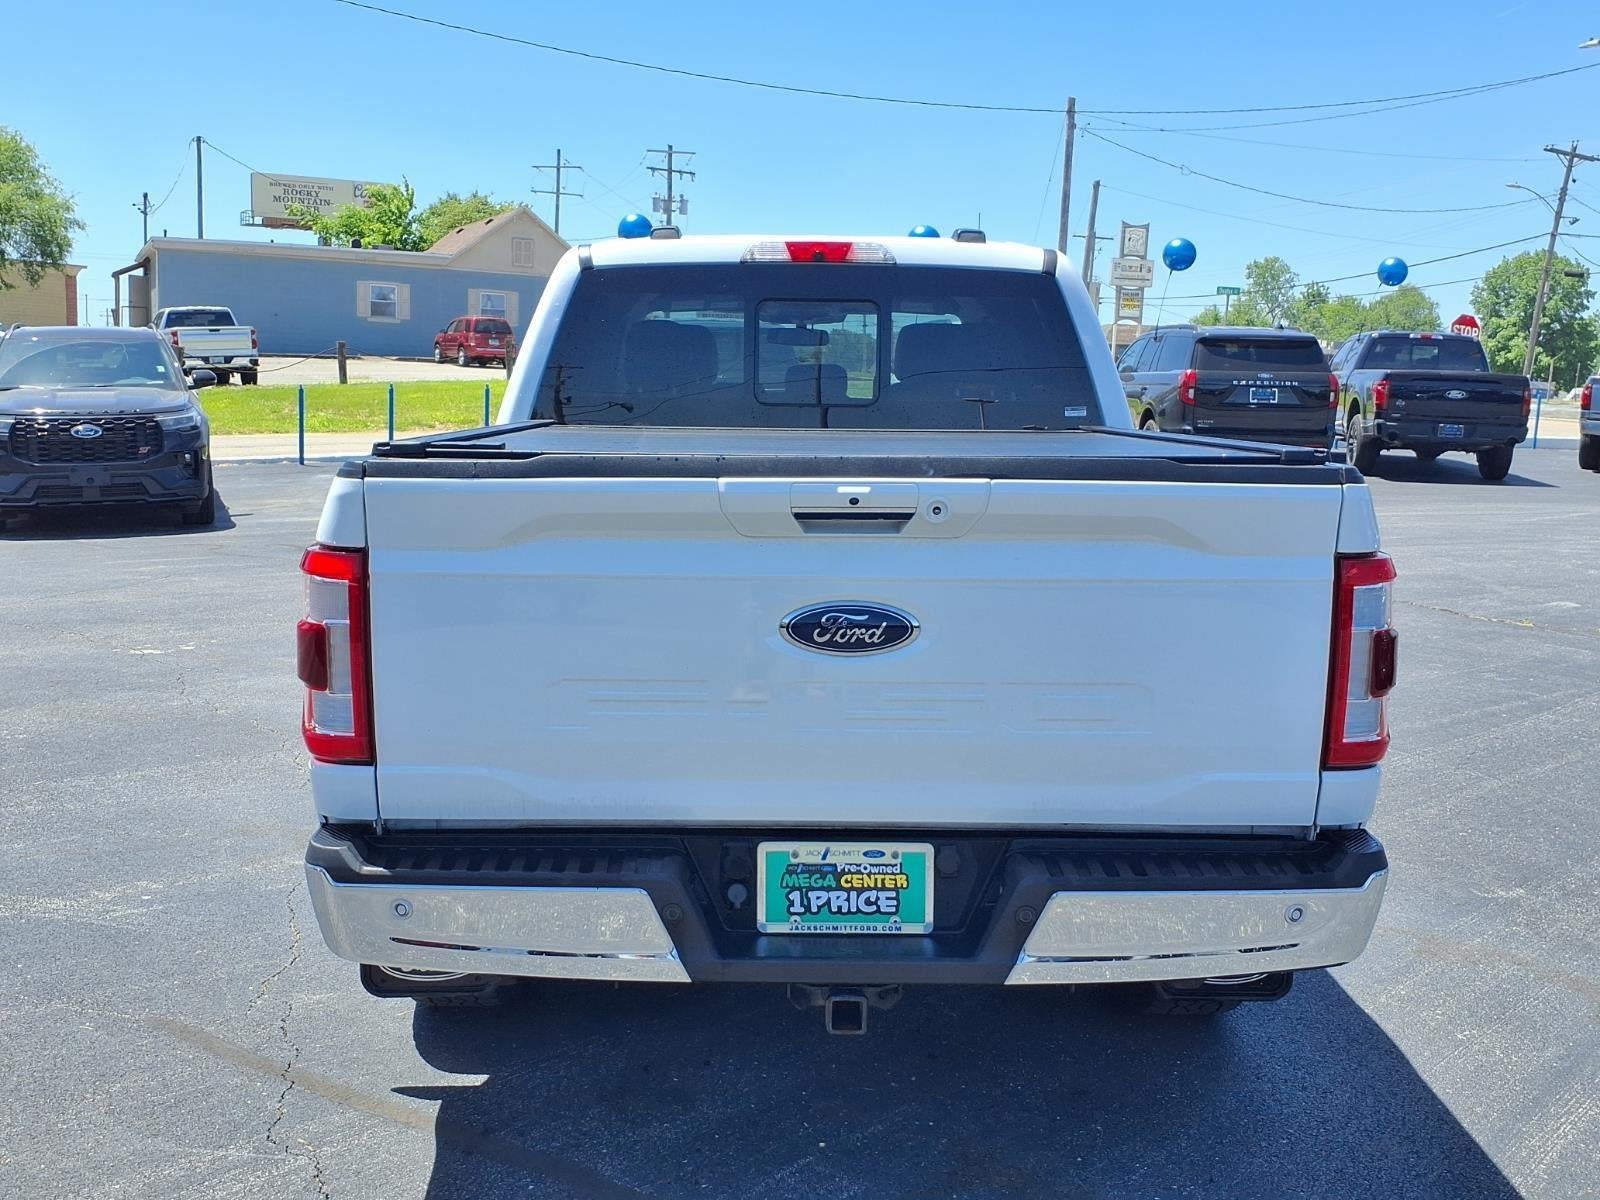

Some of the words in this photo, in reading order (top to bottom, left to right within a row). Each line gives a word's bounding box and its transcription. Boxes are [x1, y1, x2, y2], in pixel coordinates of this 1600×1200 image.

[283, 188, 321, 198] ROCKY
[272, 195, 331, 207] MOUNTAIN
[1453, 325, 1479, 337] STOP
[812, 612, 888, 643] Ford
[836, 863, 900, 873] Pre-Owned
[782, 873, 836, 888] MEGA
[840, 874, 908, 888] CENTER
[788, 890, 805, 913] 1
[807, 890, 898, 913] PRICE
[789, 924, 902, 932] JACKSCHMITTFORD.COM
